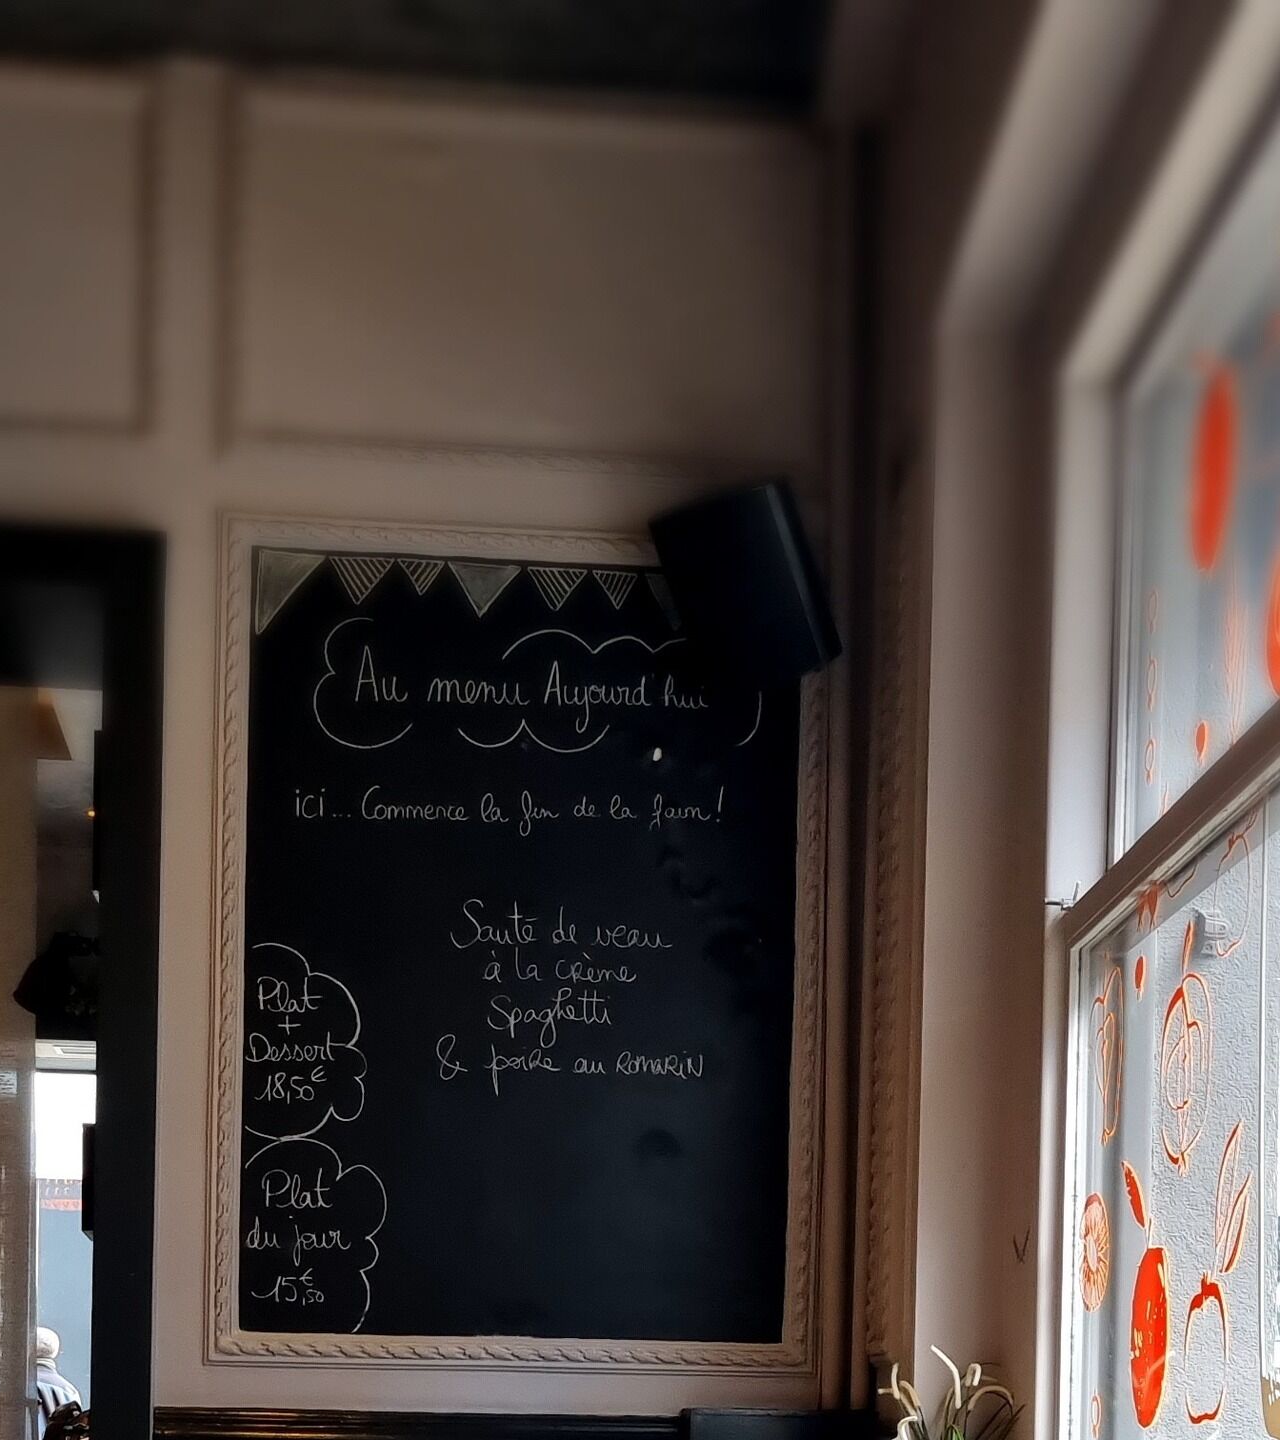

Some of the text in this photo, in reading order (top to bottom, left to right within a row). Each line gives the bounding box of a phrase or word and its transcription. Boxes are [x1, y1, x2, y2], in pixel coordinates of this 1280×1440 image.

[355, 645, 408, 703] Au
[427, 677, 530, 706] menu
[361, 785, 470, 820] Commence
[480, 792, 510, 823] la
[520, 790, 560, 836] fin
[572, 796, 597, 818] de
[608, 794, 637, 819] la
[552, 906, 577, 945] de
[591, 924, 673, 949] veau
[482, 950, 502, 983] à
[515, 947, 543, 981] la
[257, 976, 323, 1013] Plat
[487, 988, 612, 1048] Spaghetti
[245, 1031, 347, 1062] Dessert
[436, 1034, 468, 1080] &
[572, 1058, 607, 1075] au
[261, 1167, 333, 1209] Plat
[246, 1216, 352, 1267] du jour
